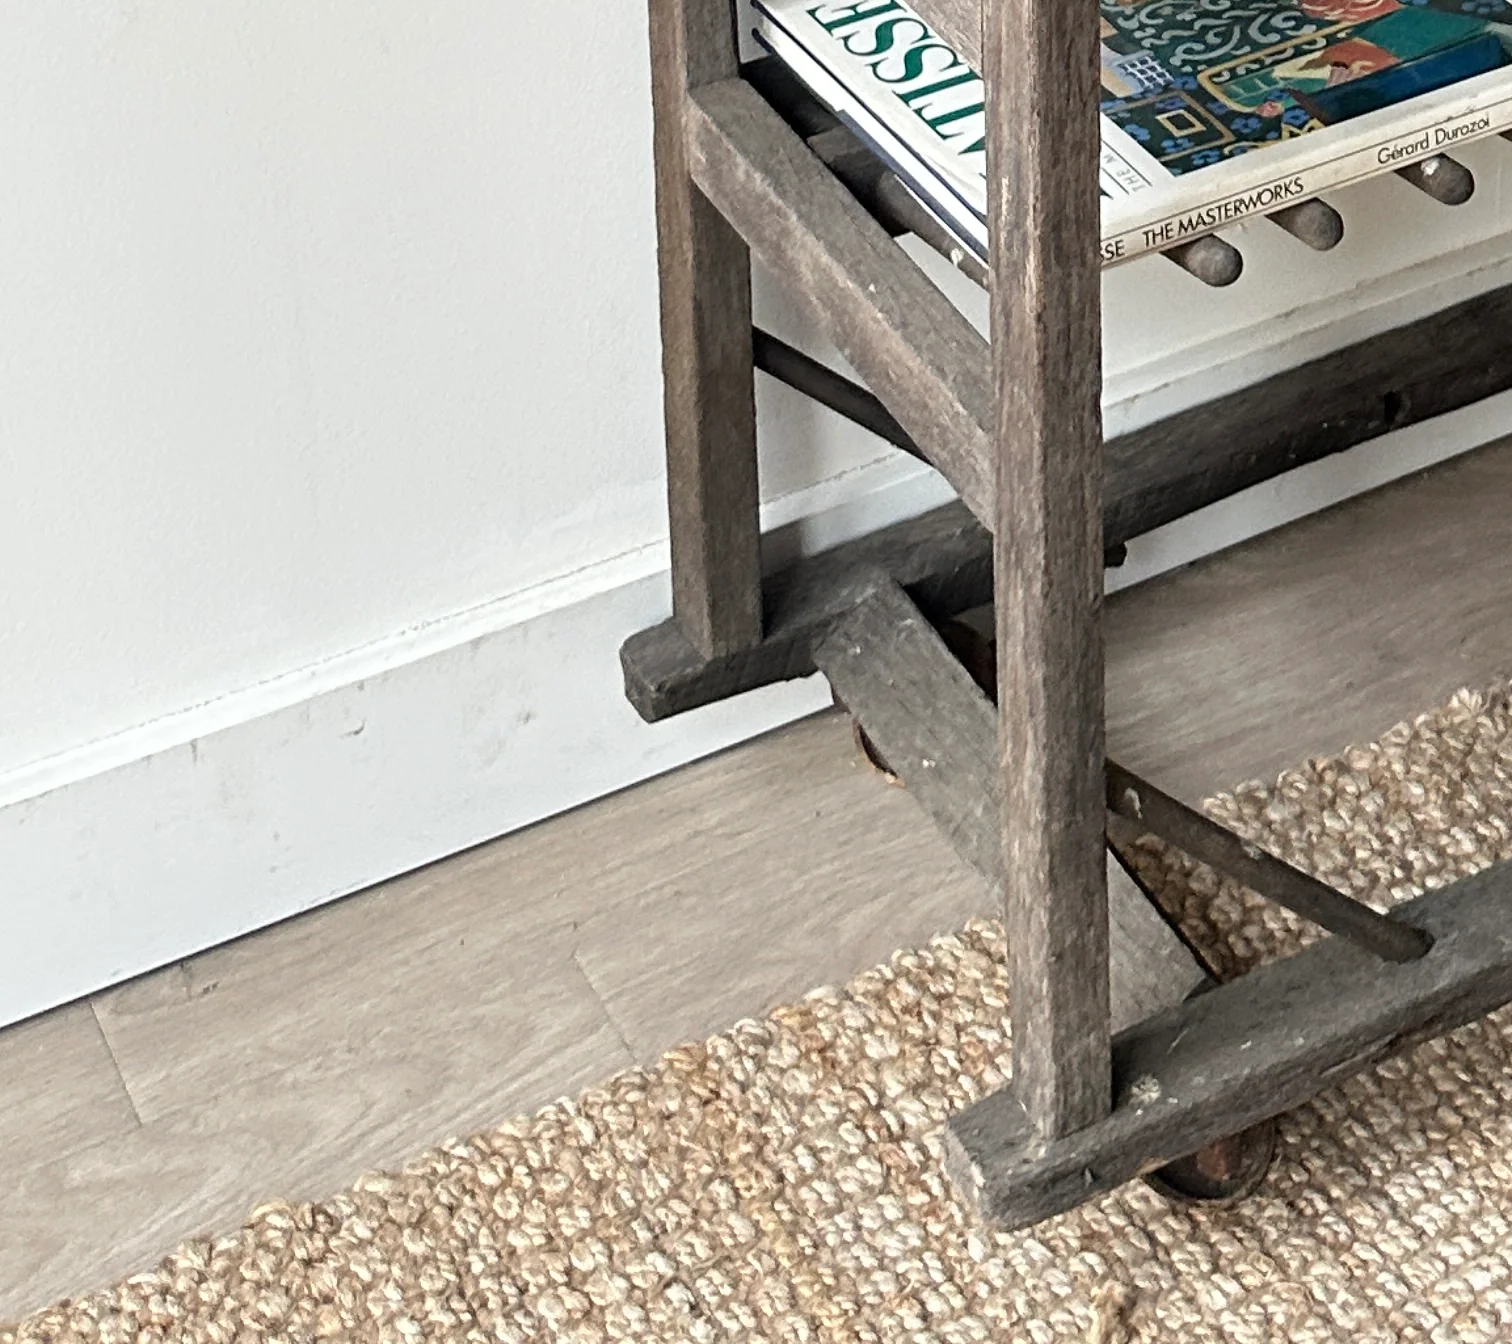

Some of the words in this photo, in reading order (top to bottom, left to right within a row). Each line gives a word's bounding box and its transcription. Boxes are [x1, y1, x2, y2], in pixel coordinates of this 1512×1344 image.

[1377, 131, 1430, 165] Gérard
[1142, 221, 1174, 248] THE
[1178, 176, 1304, 237] MASTERWORKS
